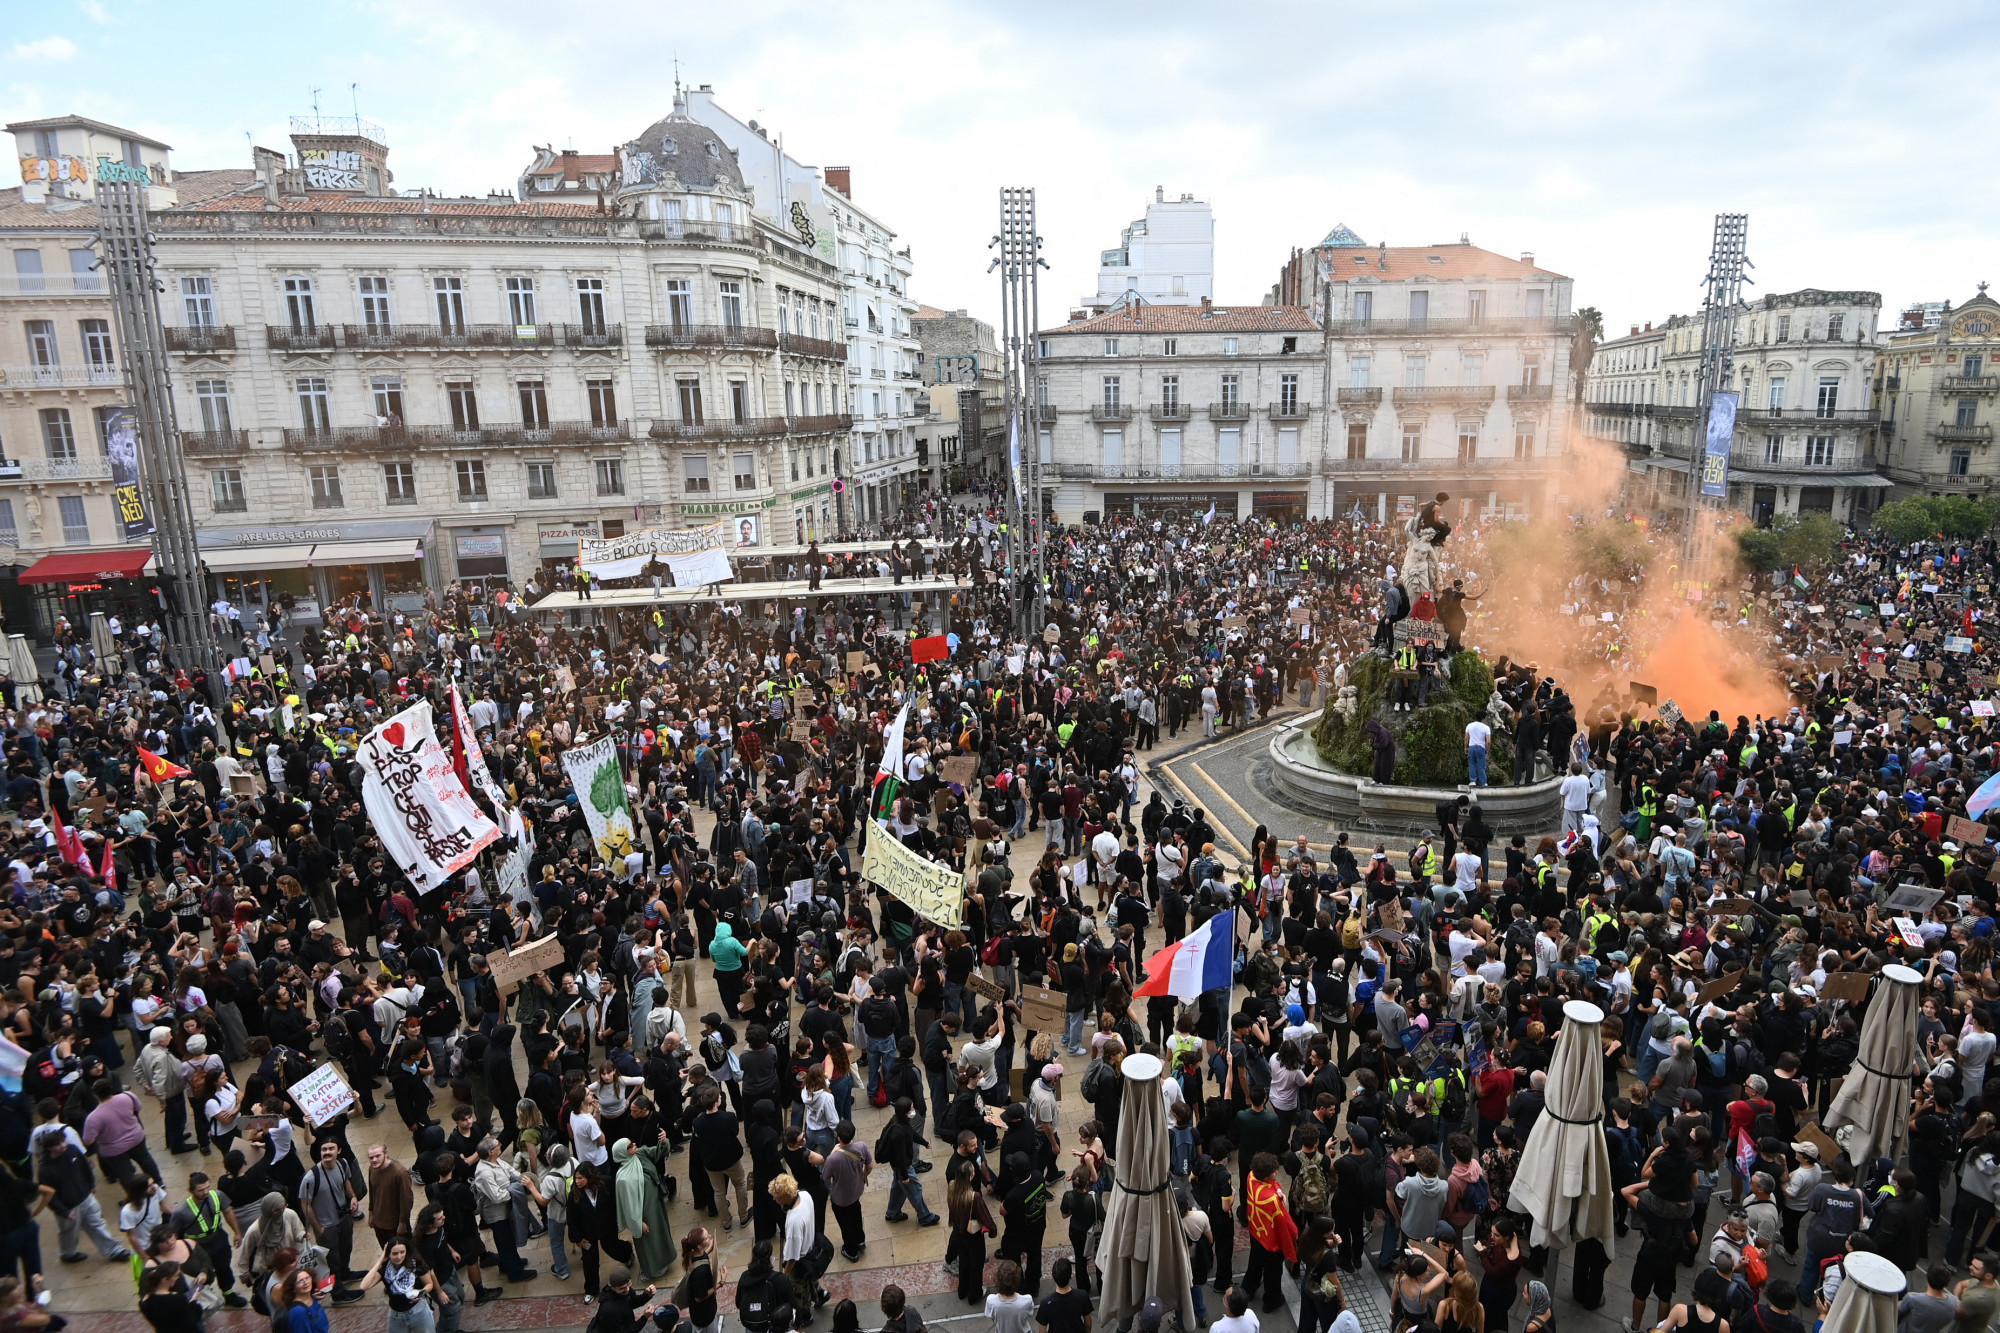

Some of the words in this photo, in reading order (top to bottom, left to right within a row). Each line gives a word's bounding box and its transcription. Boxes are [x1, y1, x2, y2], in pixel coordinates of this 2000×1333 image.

[1963, 322, 1992, 333] MIDI
[680, 502, 745, 514] PHARMACIE
[299, 528, 340, 539] GRACES
[541, 530, 569, 539] PIZZA
[589, 550, 610, 562] LES
[613, 541, 658, 560] BLOCUS
[381, 763, 423, 795] TROP
[394, 785, 424, 814] CE
[405, 806, 433, 832] QUI
[415, 824, 434, 851] SE
[1826, 1198, 1855, 1209] SONIC
